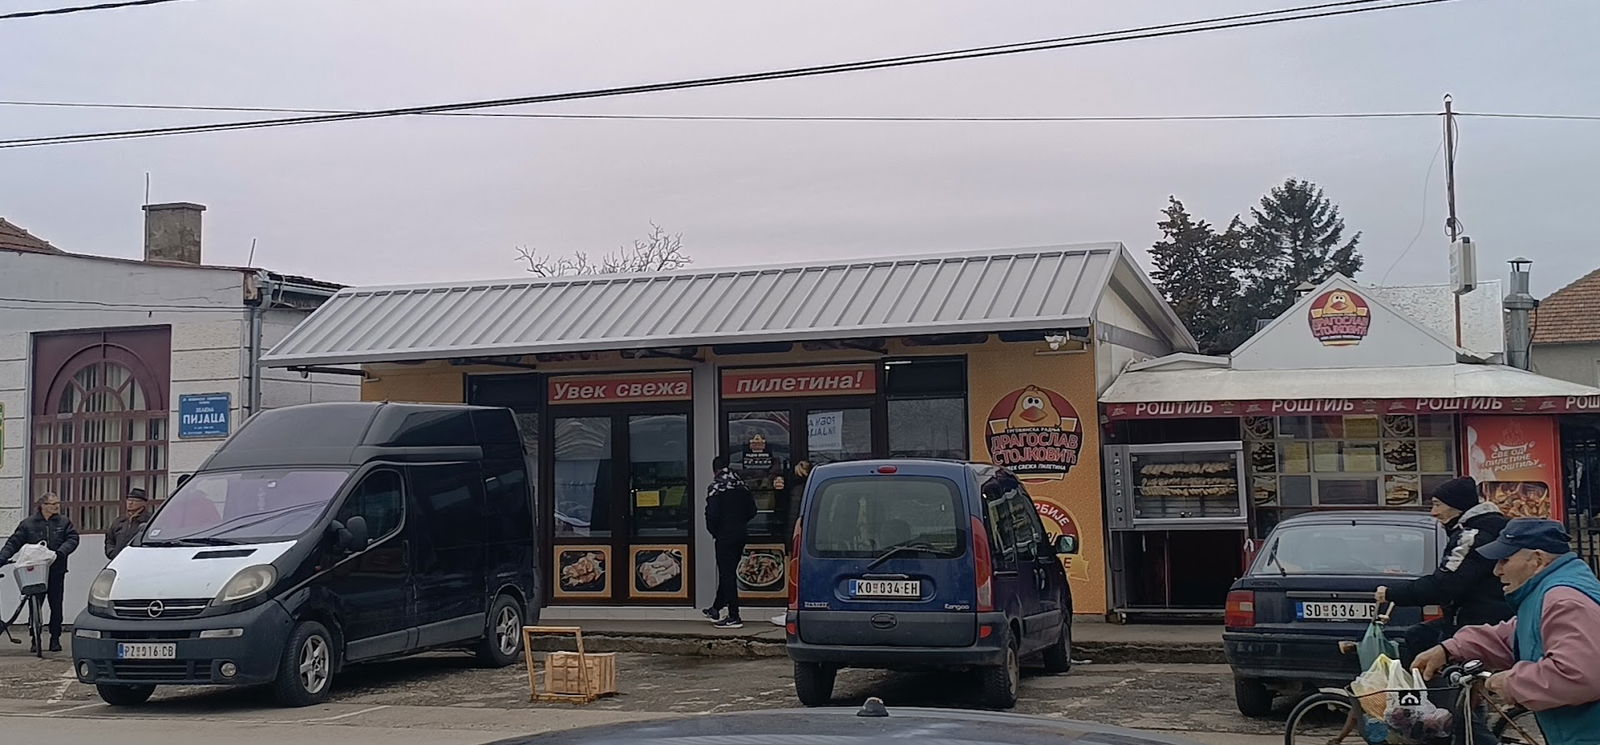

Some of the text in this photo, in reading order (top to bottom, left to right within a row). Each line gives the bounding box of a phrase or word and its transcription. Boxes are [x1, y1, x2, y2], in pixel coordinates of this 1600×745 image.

[736, 371, 864, 392] пилетина!
[553, 381, 688, 400] Увек свежа
[1135, 401, 1214, 415] РОШТИЉ
[1271, 399, 1354, 412] РОШТИЉ
[1416, 398, 1503, 411] РОШТИЉ
[183, 413, 226, 425] ПИЈАЦА
[991, 432, 1079, 451] ДРАГОСЛАВ
[992, 447, 1077, 465] СТОЈКОВИЋ
[1491, 451, 1509, 459] СВЕ
[1033, 502, 1070, 527] РБИЈЕ
[857, 582, 872, 594] KO
[1305, 604, 1321, 617] SD
